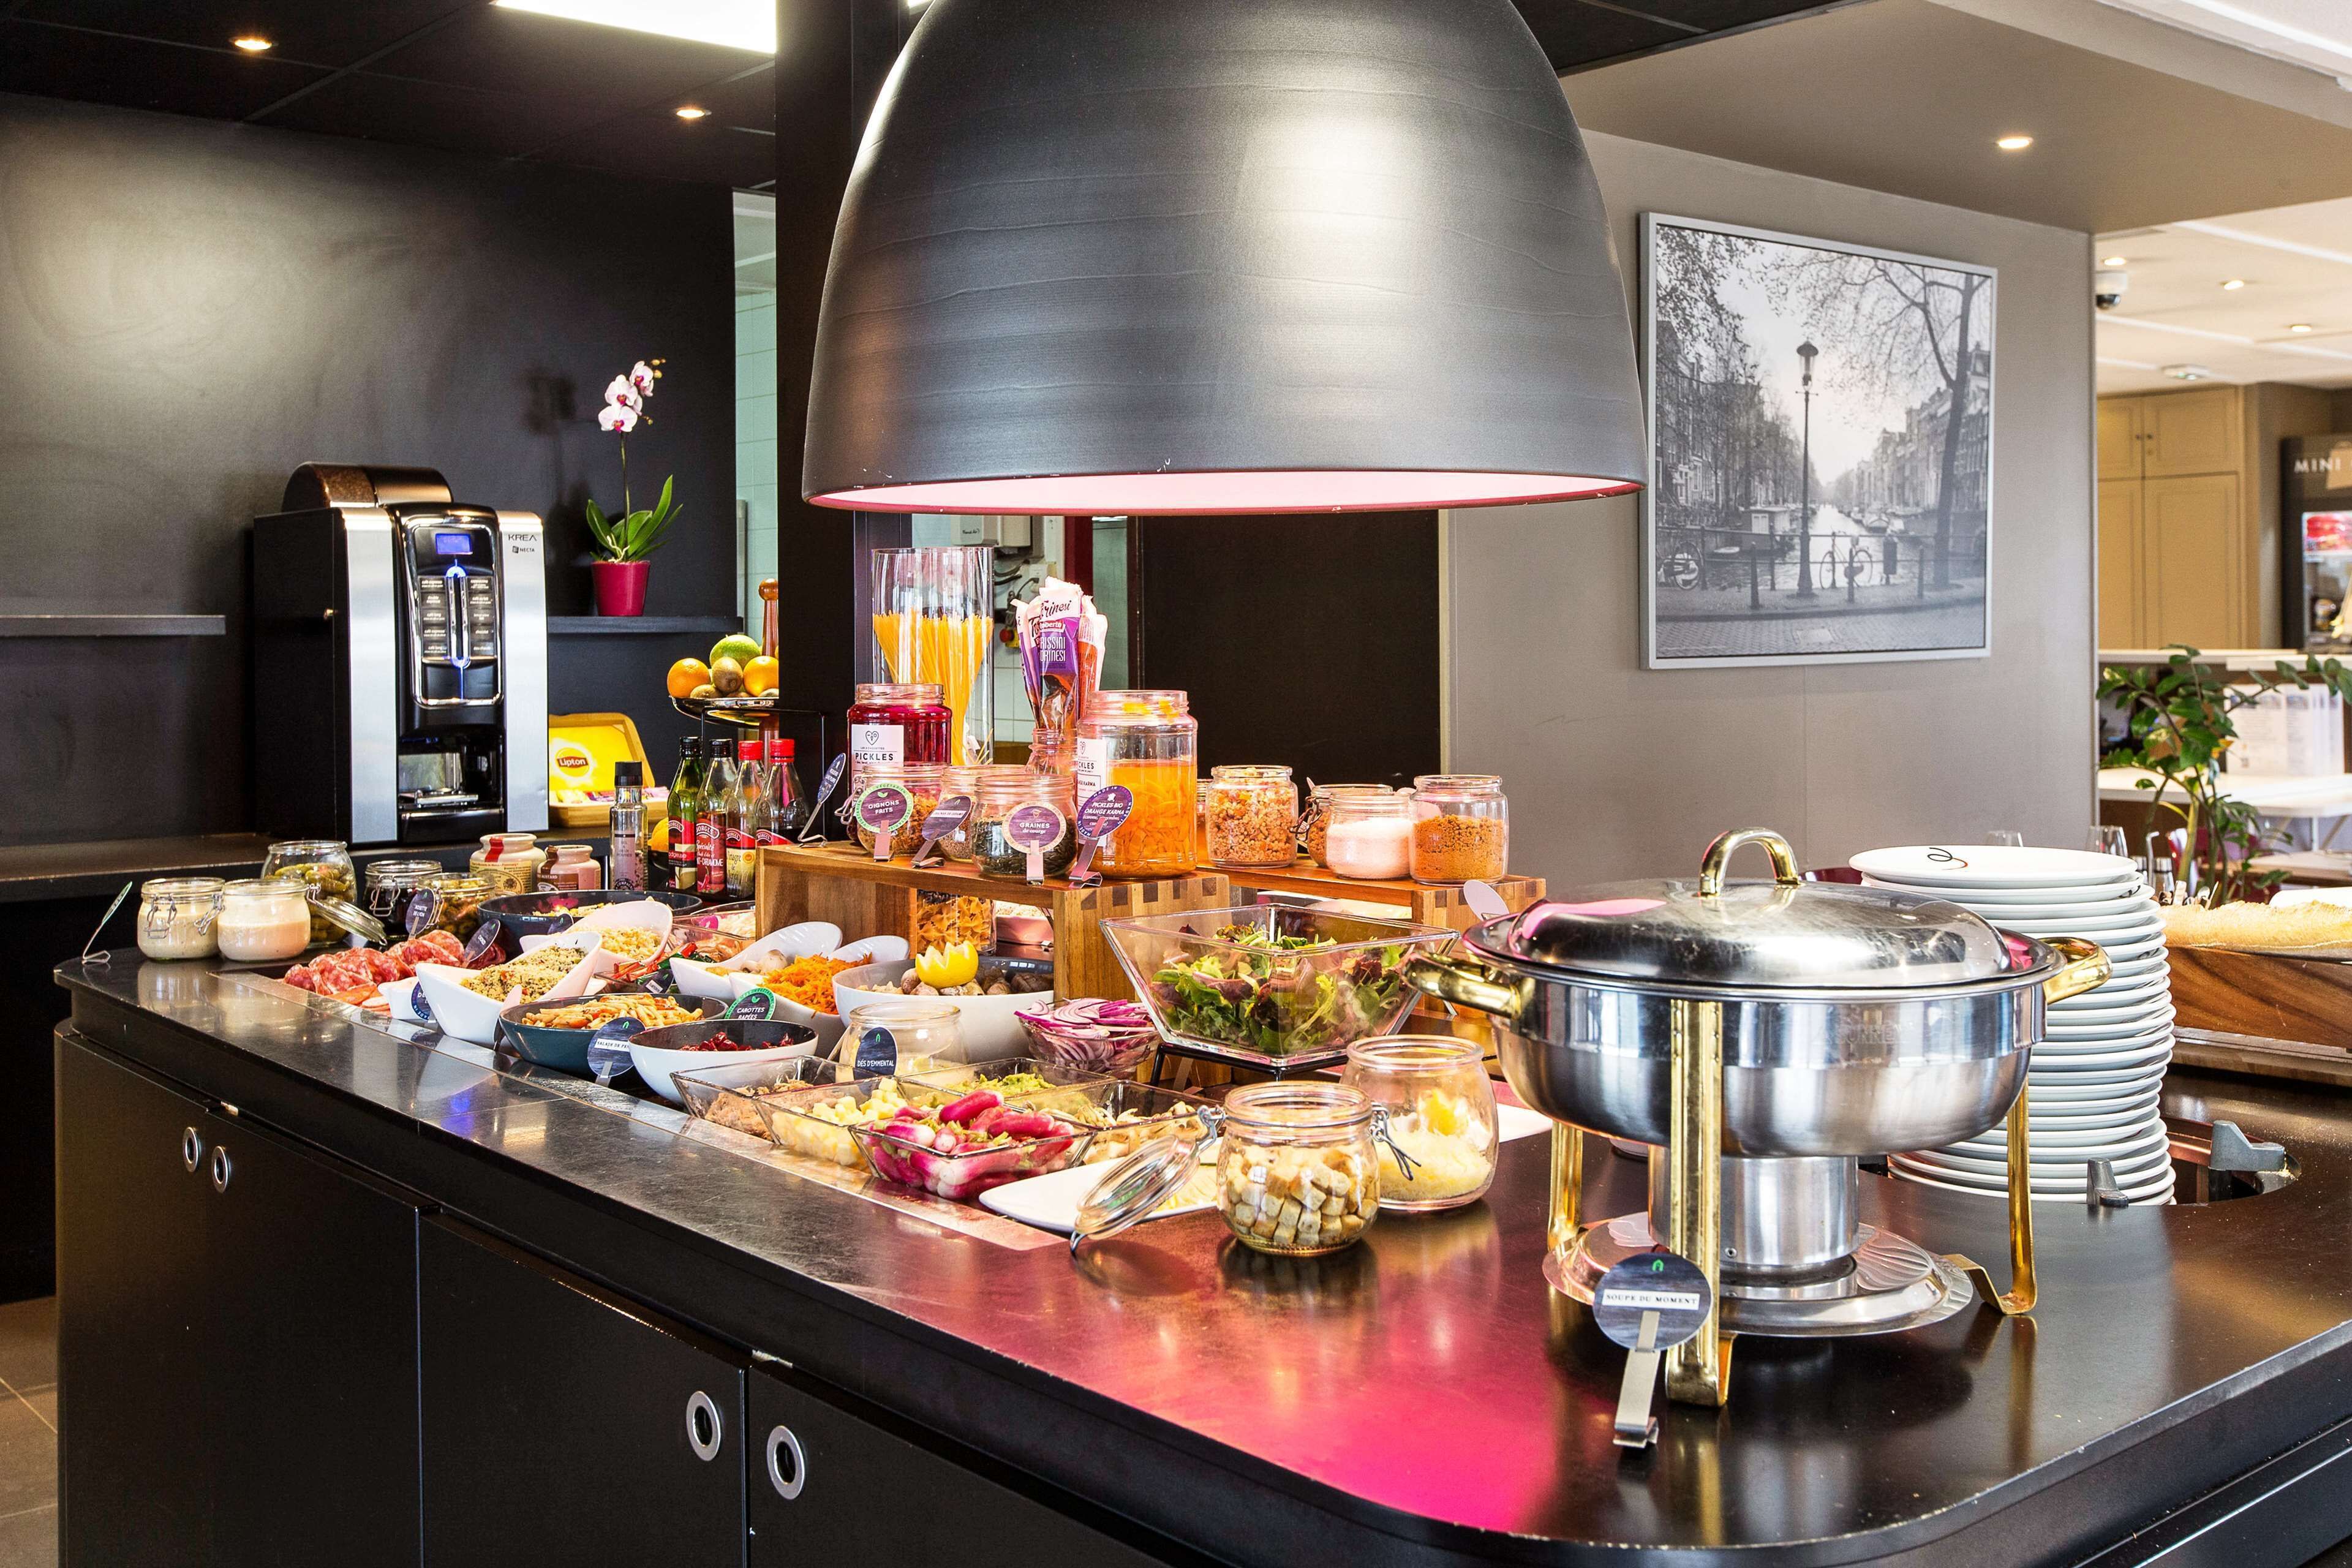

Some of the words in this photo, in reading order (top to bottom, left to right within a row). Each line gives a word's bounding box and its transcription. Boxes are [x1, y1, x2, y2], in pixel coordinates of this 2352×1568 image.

[2294, 458, 2341, 473] MINI
[1040, 637, 1066, 649] RISSINI
[1040, 650, 1066, 662] ORINESI
[855, 752, 894, 761] PICKLES
[559, 758, 586, 767] Lipton
[868, 799, 900, 809] OIGNONS
[857, 1058, 866, 1067] DÉS
[1656, 1296, 1697, 1305] MOMENT
